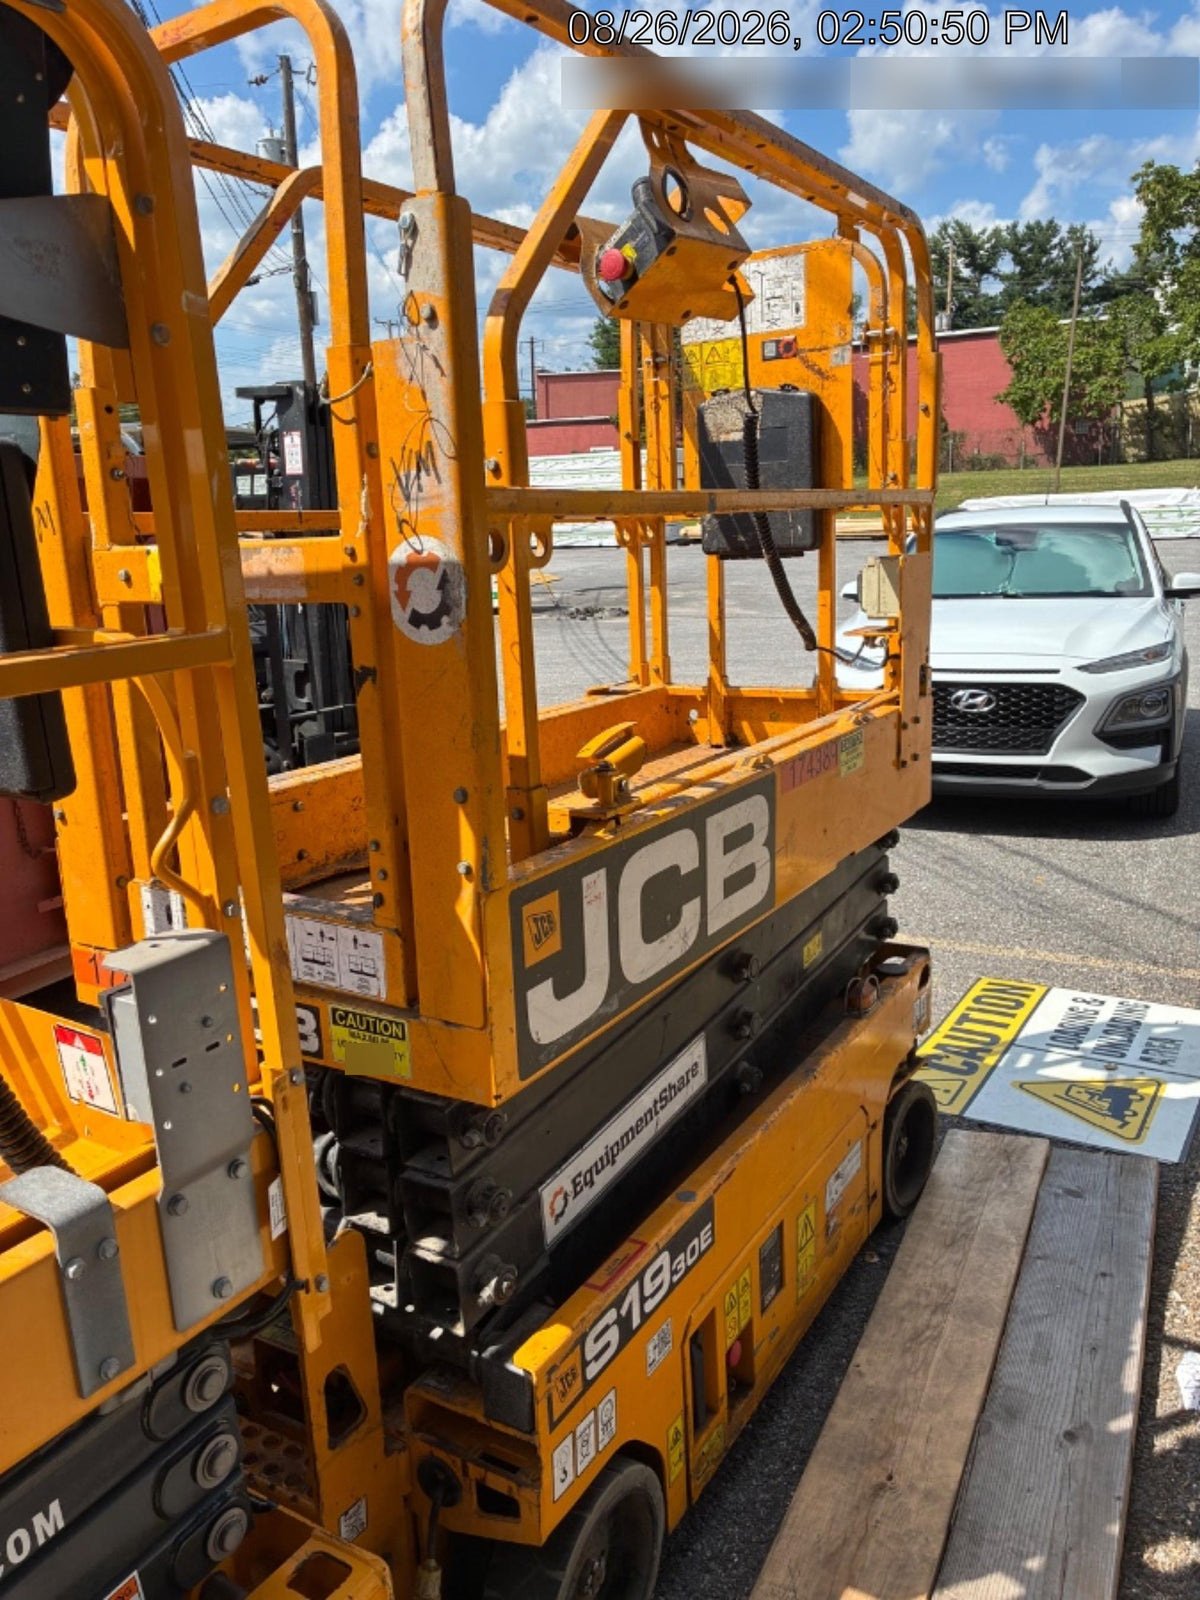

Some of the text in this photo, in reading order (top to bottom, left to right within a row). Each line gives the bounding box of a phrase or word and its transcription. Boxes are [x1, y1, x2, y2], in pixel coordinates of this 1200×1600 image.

[526, 794, 771, 1045] JCB
[532, 913, 555, 945] JCB
[335, 1010, 403, 1039] CAUTION
[927, 981, 1036, 1077] CAUTION
[1045, 996, 1106, 1053] LOADING &
[1091, 1000, 1151, 1059] UNLOADING
[1139, 1035, 1185, 1067] AREA
[571, 1060, 699, 1201] EquipmentShare
